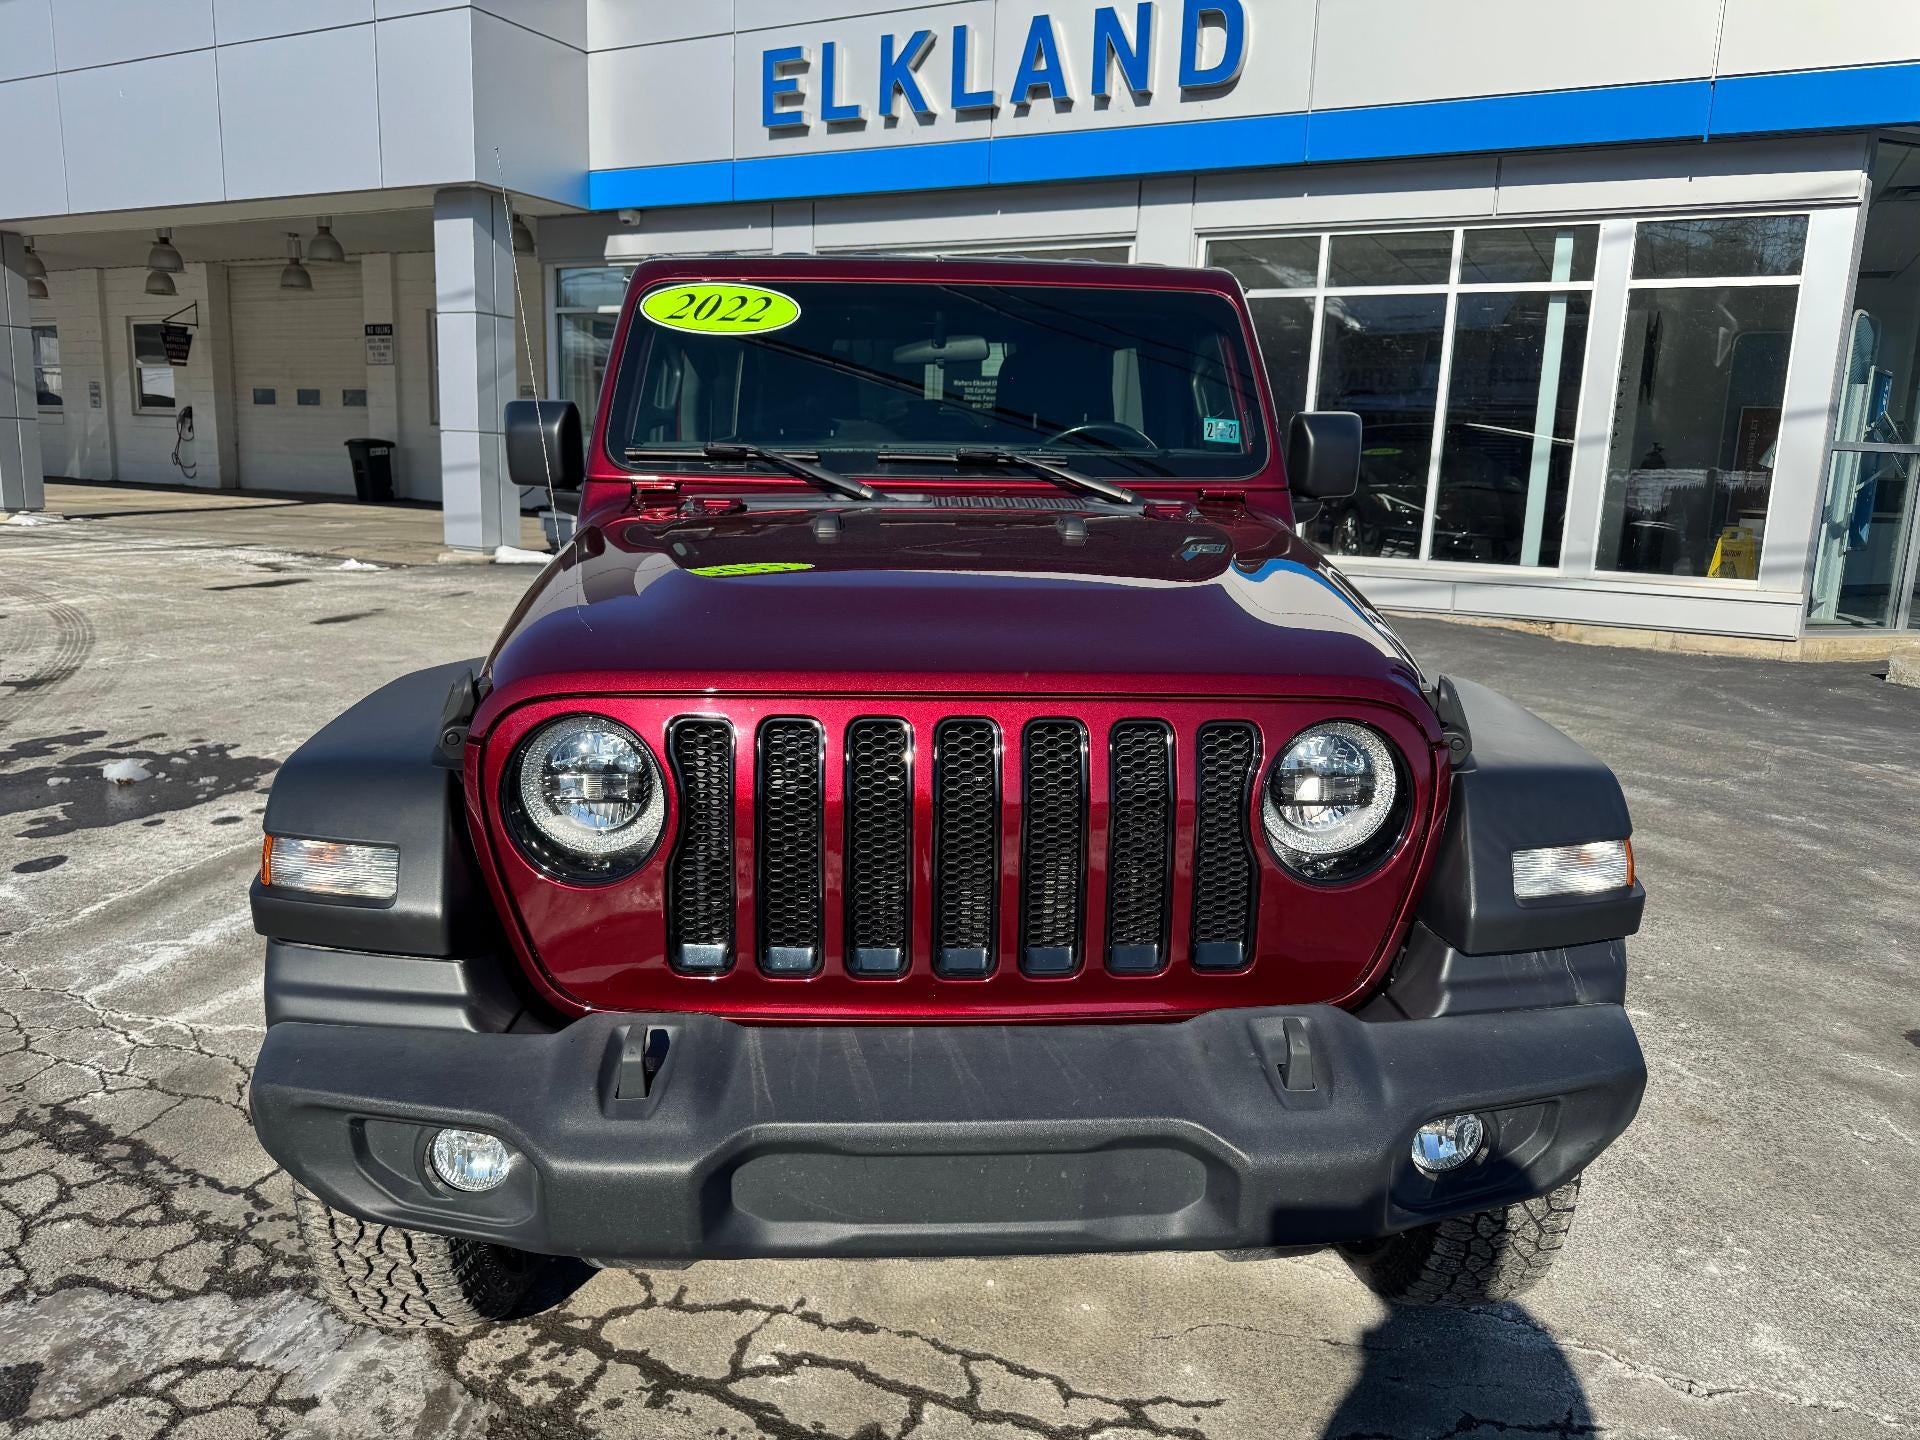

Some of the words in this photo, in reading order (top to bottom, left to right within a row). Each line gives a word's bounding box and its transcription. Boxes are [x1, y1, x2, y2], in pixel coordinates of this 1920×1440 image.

[763, 0, 1245, 128] ELKLAND
[664, 293, 773, 323] 2022
[375, 326, 391, 335] IDLING
[1206, 422, 1214, 438] 2
